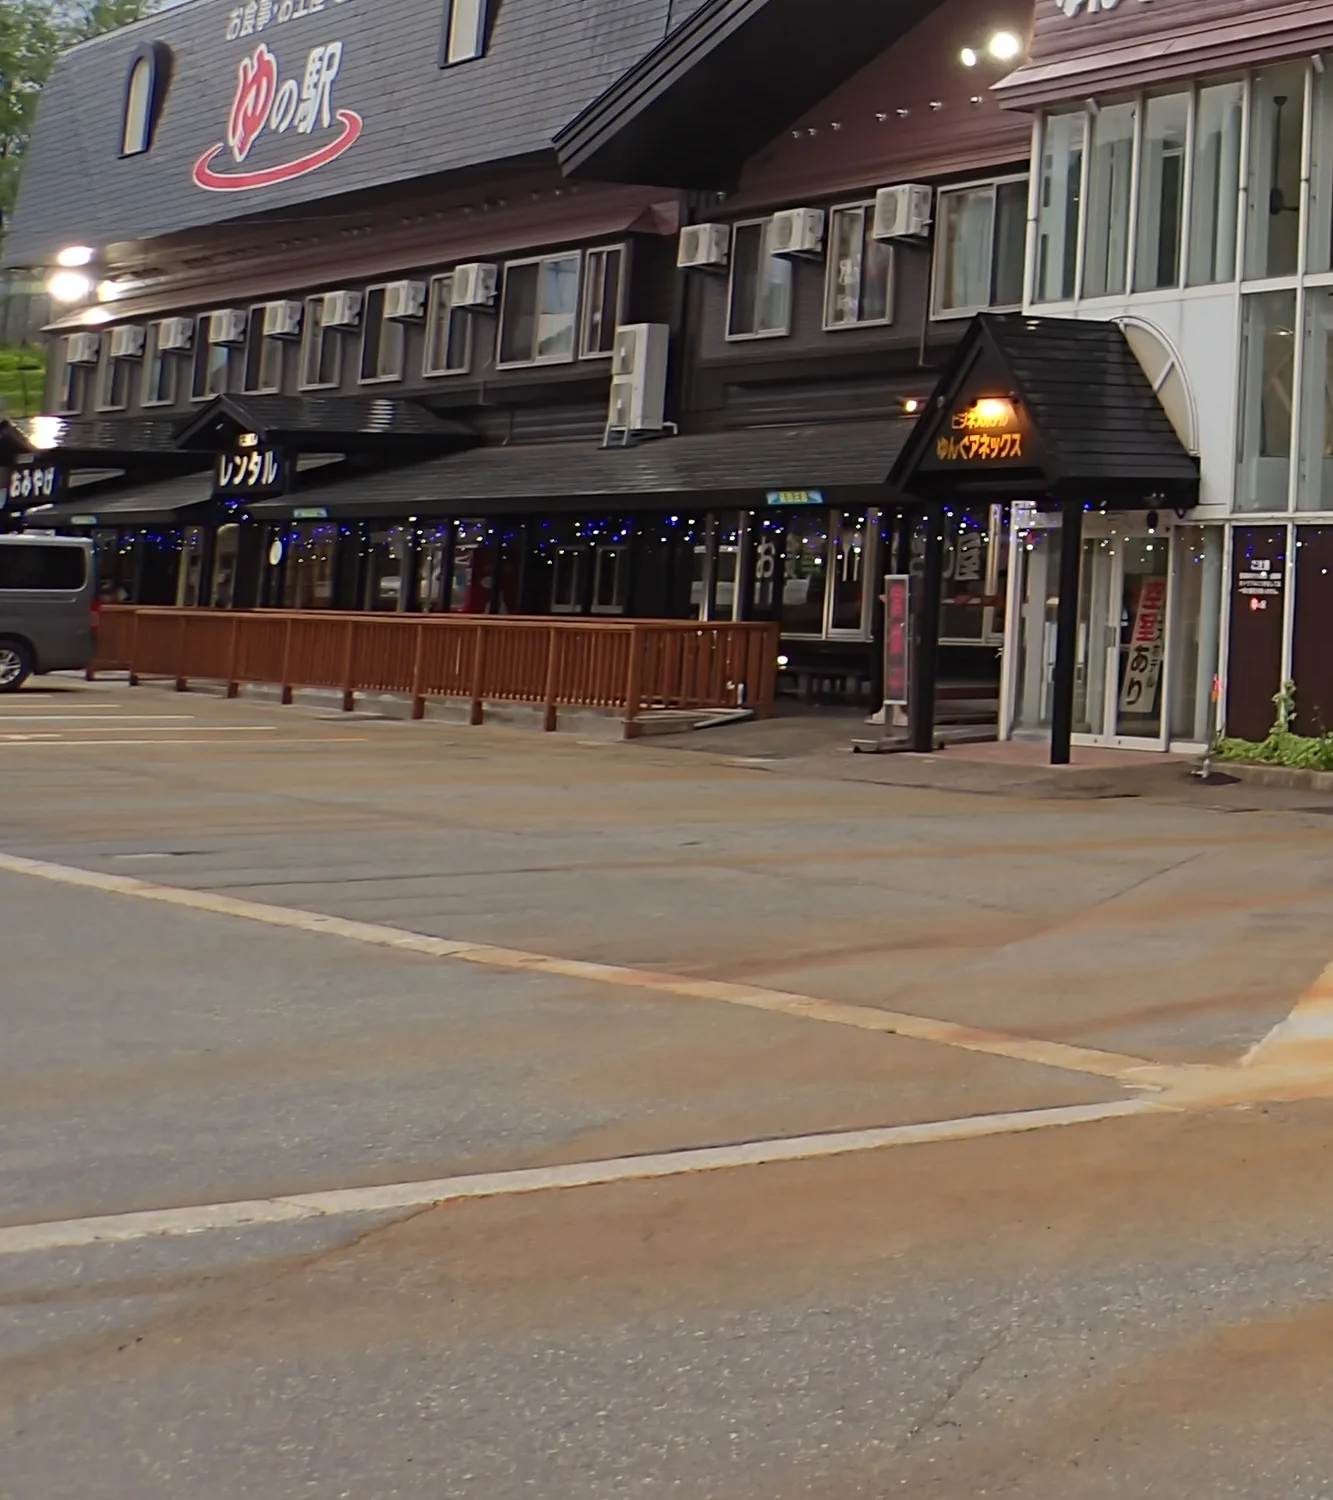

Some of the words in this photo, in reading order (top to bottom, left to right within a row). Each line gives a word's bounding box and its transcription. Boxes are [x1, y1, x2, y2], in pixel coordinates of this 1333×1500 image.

[228, 41, 344, 163] ゆの駅
[936, 433, 1022, 460] ゆんぐアネックス
[10, 466, 56, 499] おみやげ
[218, 450, 279, 488] レンタル
